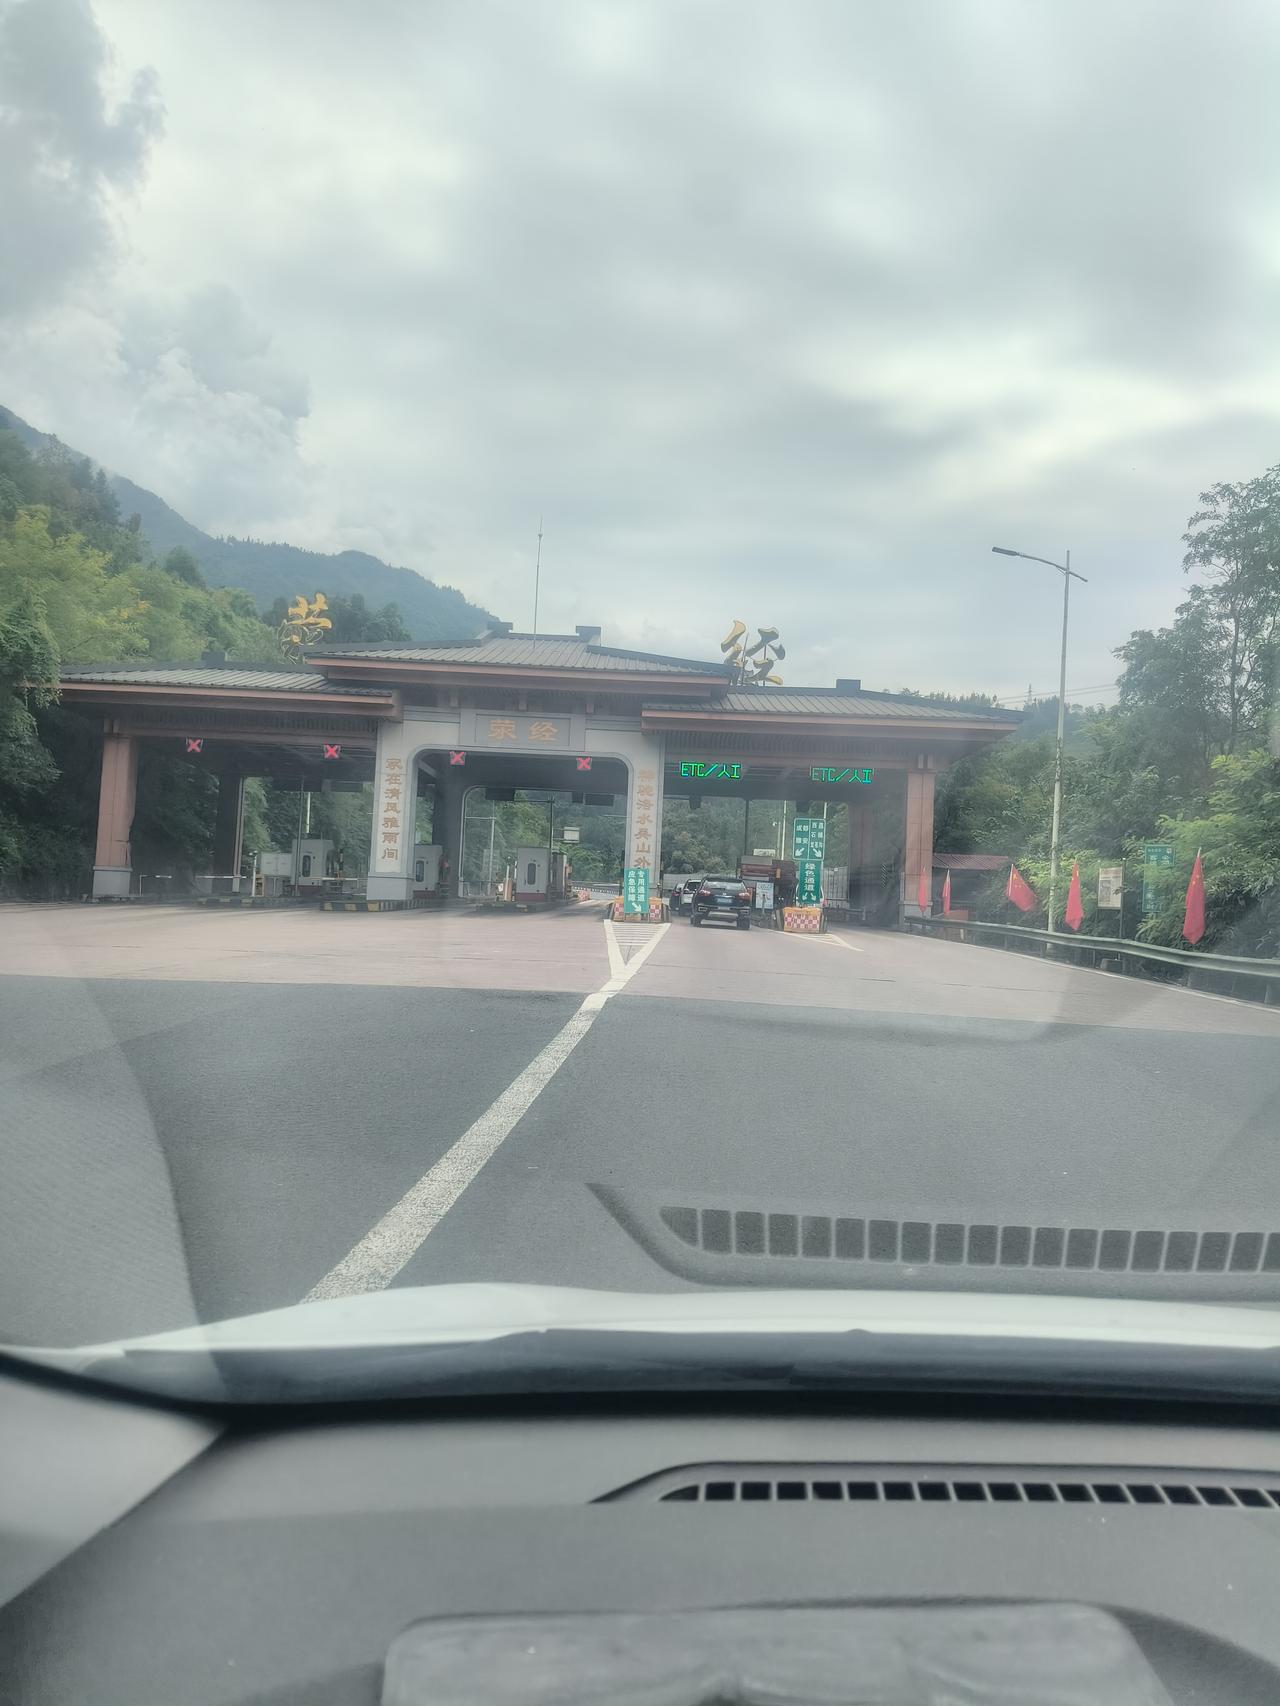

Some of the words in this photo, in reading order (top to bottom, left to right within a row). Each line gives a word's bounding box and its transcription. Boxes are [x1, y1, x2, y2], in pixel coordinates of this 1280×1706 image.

[680, 762, 741, 778] ETC/人工
[811, 767, 872, 783] ETC/人工
[628, 870, 636, 901] 应急保障
[637, 870, 645, 901] 专用通道
[804, 862, 816, 891] 绿色通道
